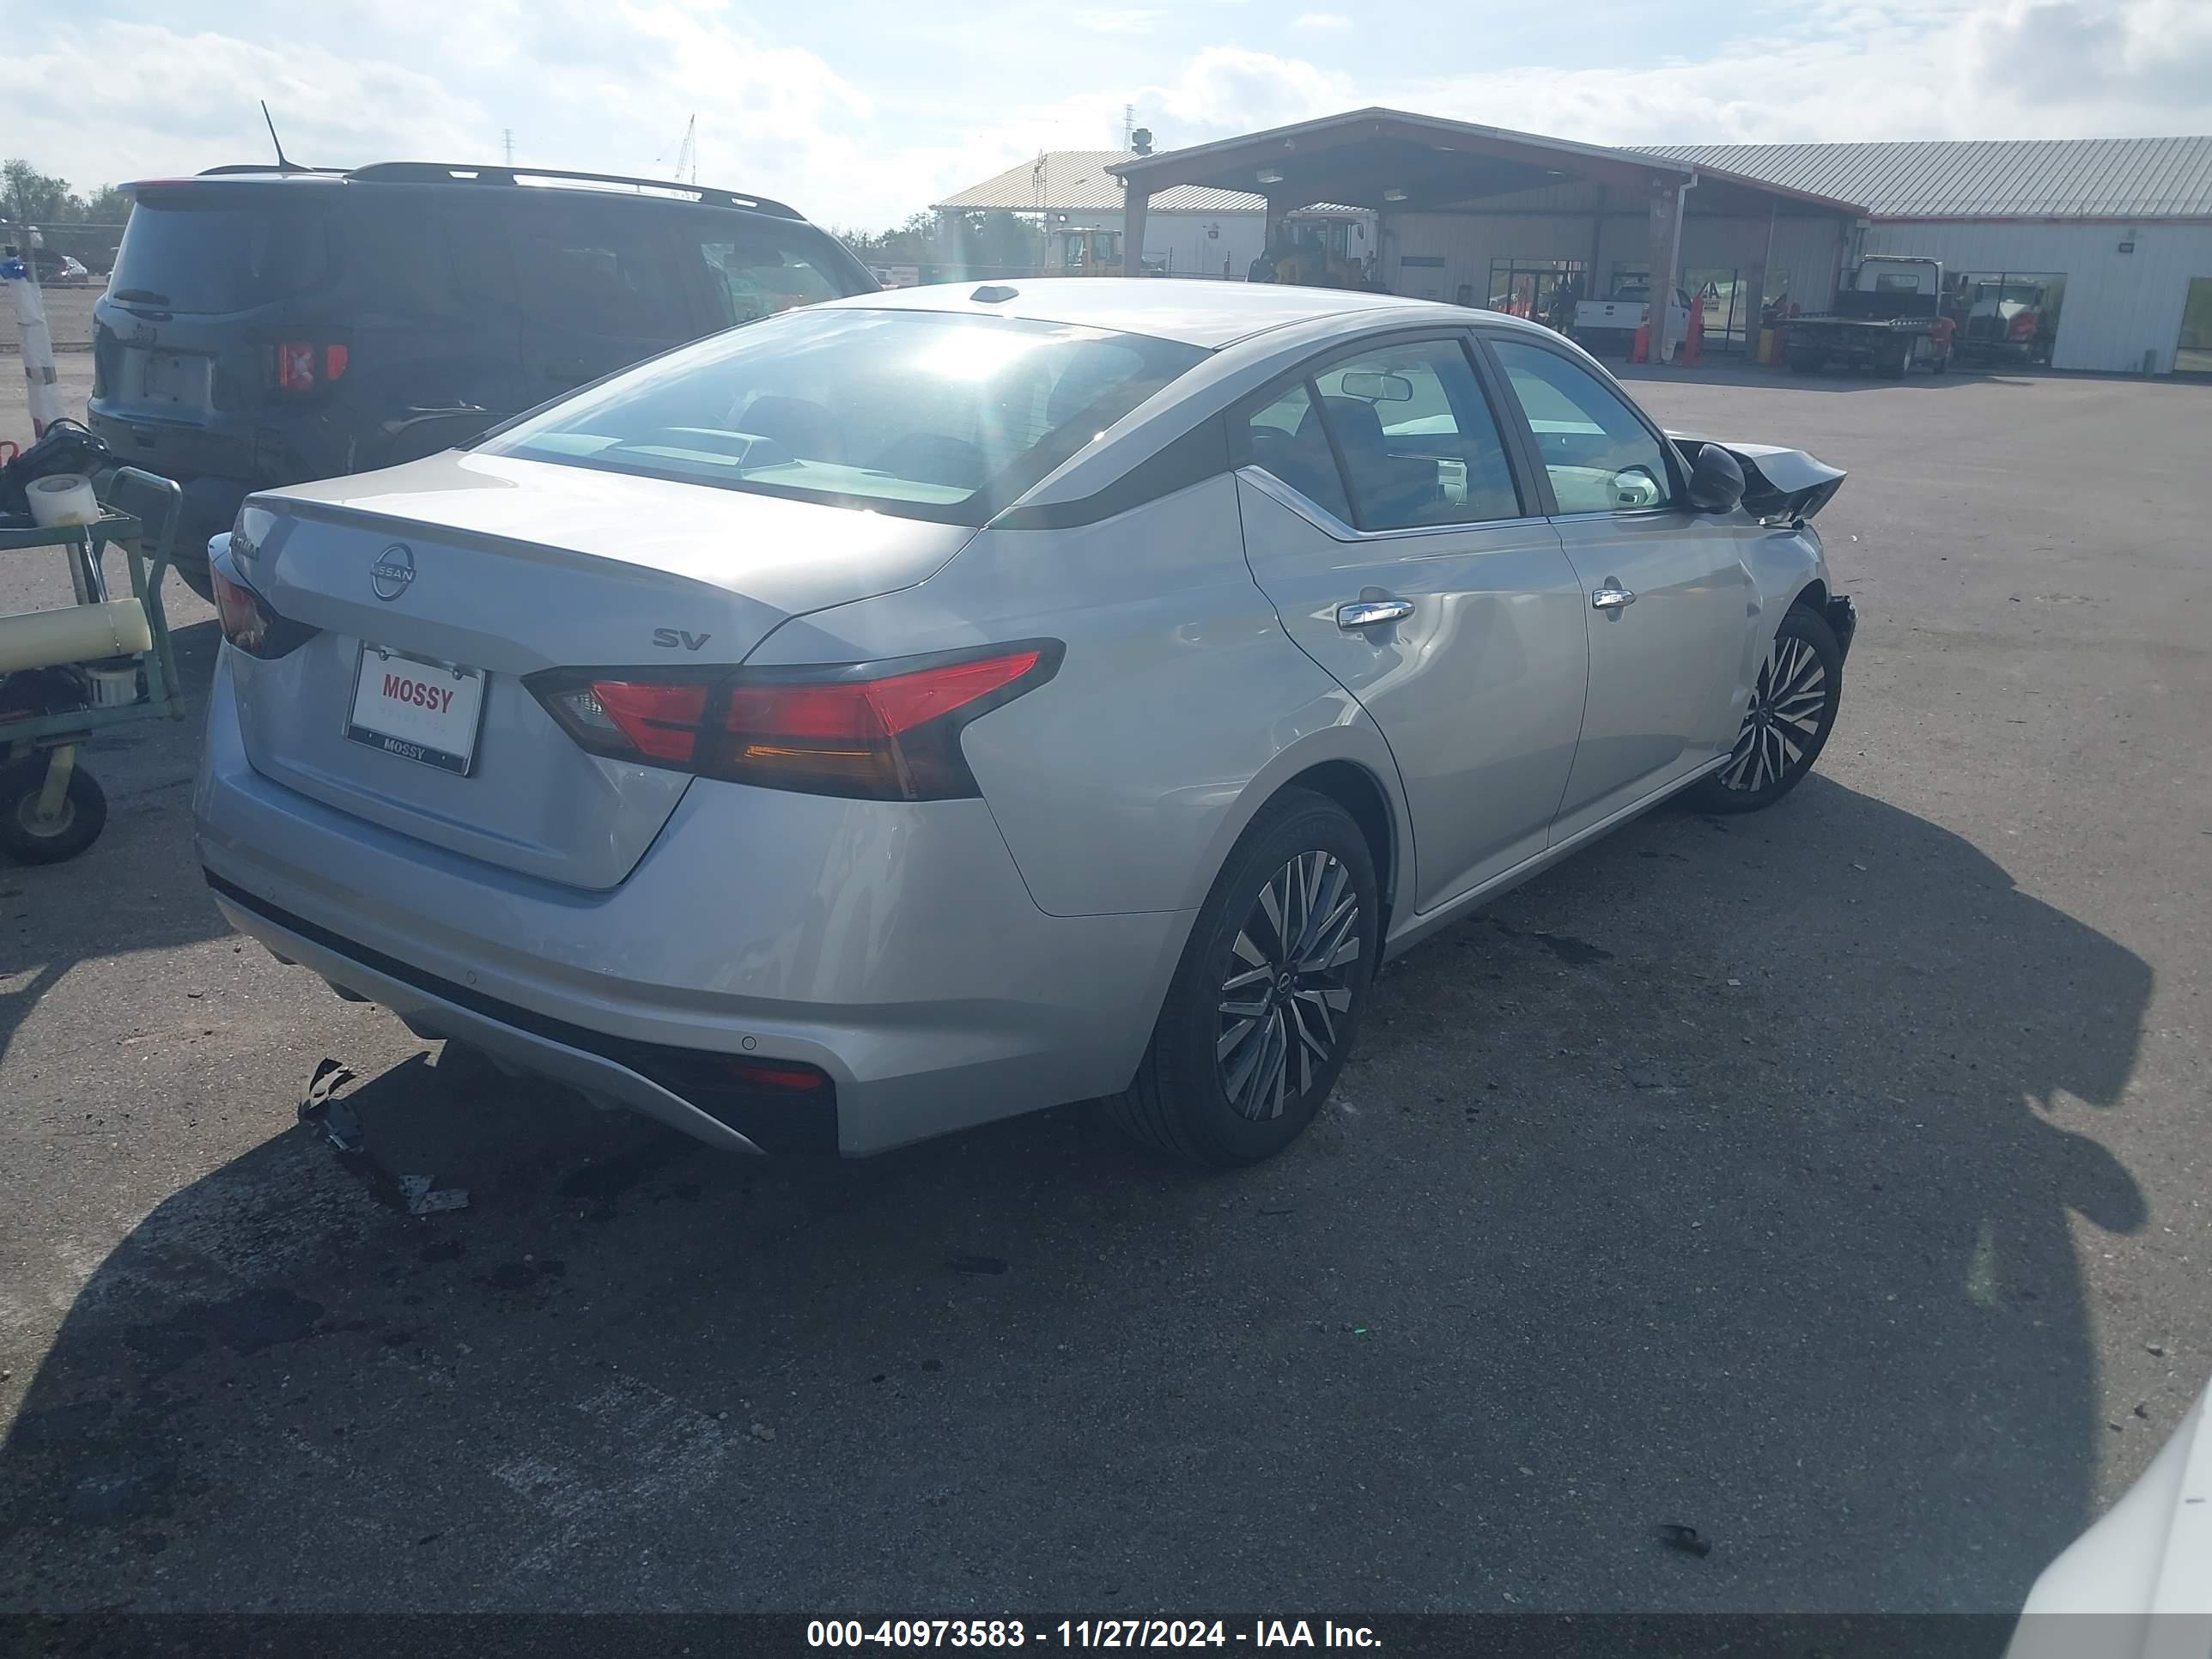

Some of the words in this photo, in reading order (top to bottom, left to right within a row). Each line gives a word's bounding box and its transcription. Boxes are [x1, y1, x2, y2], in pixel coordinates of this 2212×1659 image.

[373, 563, 414, 581] SSAN
[653, 628, 711, 651] SV
[383, 674, 453, 714] MOSSY
[384, 738, 426, 760] MOSSY
